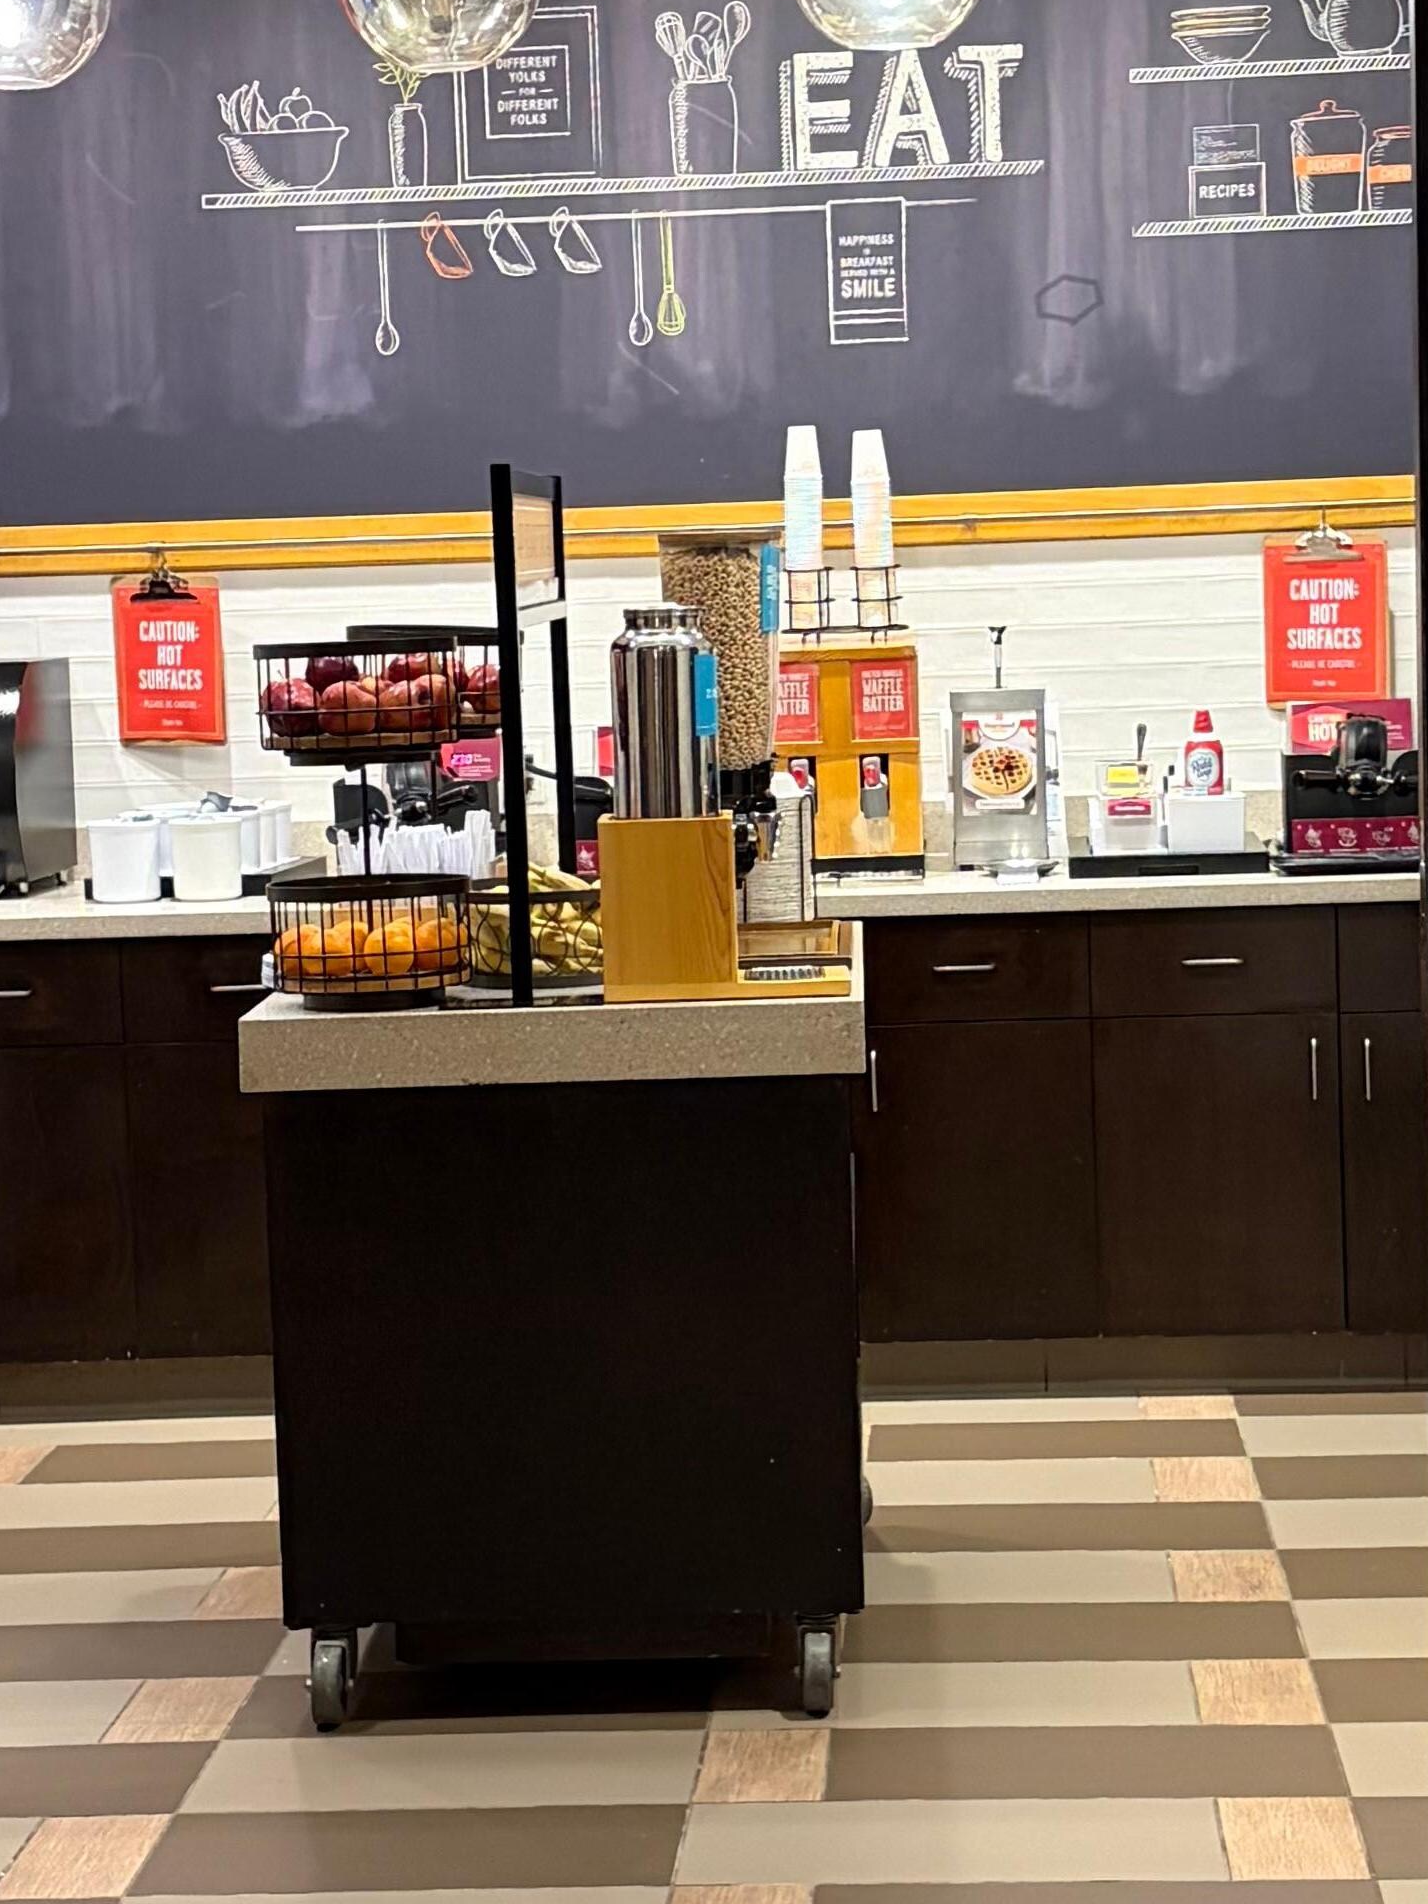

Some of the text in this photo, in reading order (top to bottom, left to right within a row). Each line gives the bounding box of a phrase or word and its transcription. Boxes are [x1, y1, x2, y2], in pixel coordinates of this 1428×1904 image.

[495, 55, 557, 70] DIFFERENT
[508, 70, 546, 83] YOLKS
[518, 87, 536, 96] FOR
[497, 98, 559, 113] DIFFERENT
[778, 43, 1024, 171] EAT
[510, 113, 547, 126] FOLKS
[1199, 183, 1256, 199] RECIPES
[838, 233, 894, 246] HAPPINESS
[840, 256, 894, 268] BREAKFAST
[841, 277, 896, 299] SMILE
[1289, 578, 1360, 601] CAUTION:
[1308, 603, 1340, 625] HOT
[139, 620, 200, 642] CAUTION:
[1286, 627, 1362, 650] SURFACES
[157, 645, 183, 667] HOT
[138, 669, 203, 690] SURFACES
[862, 678, 904, 695] WAFFLE
[862, 695, 904, 713] BATTER
